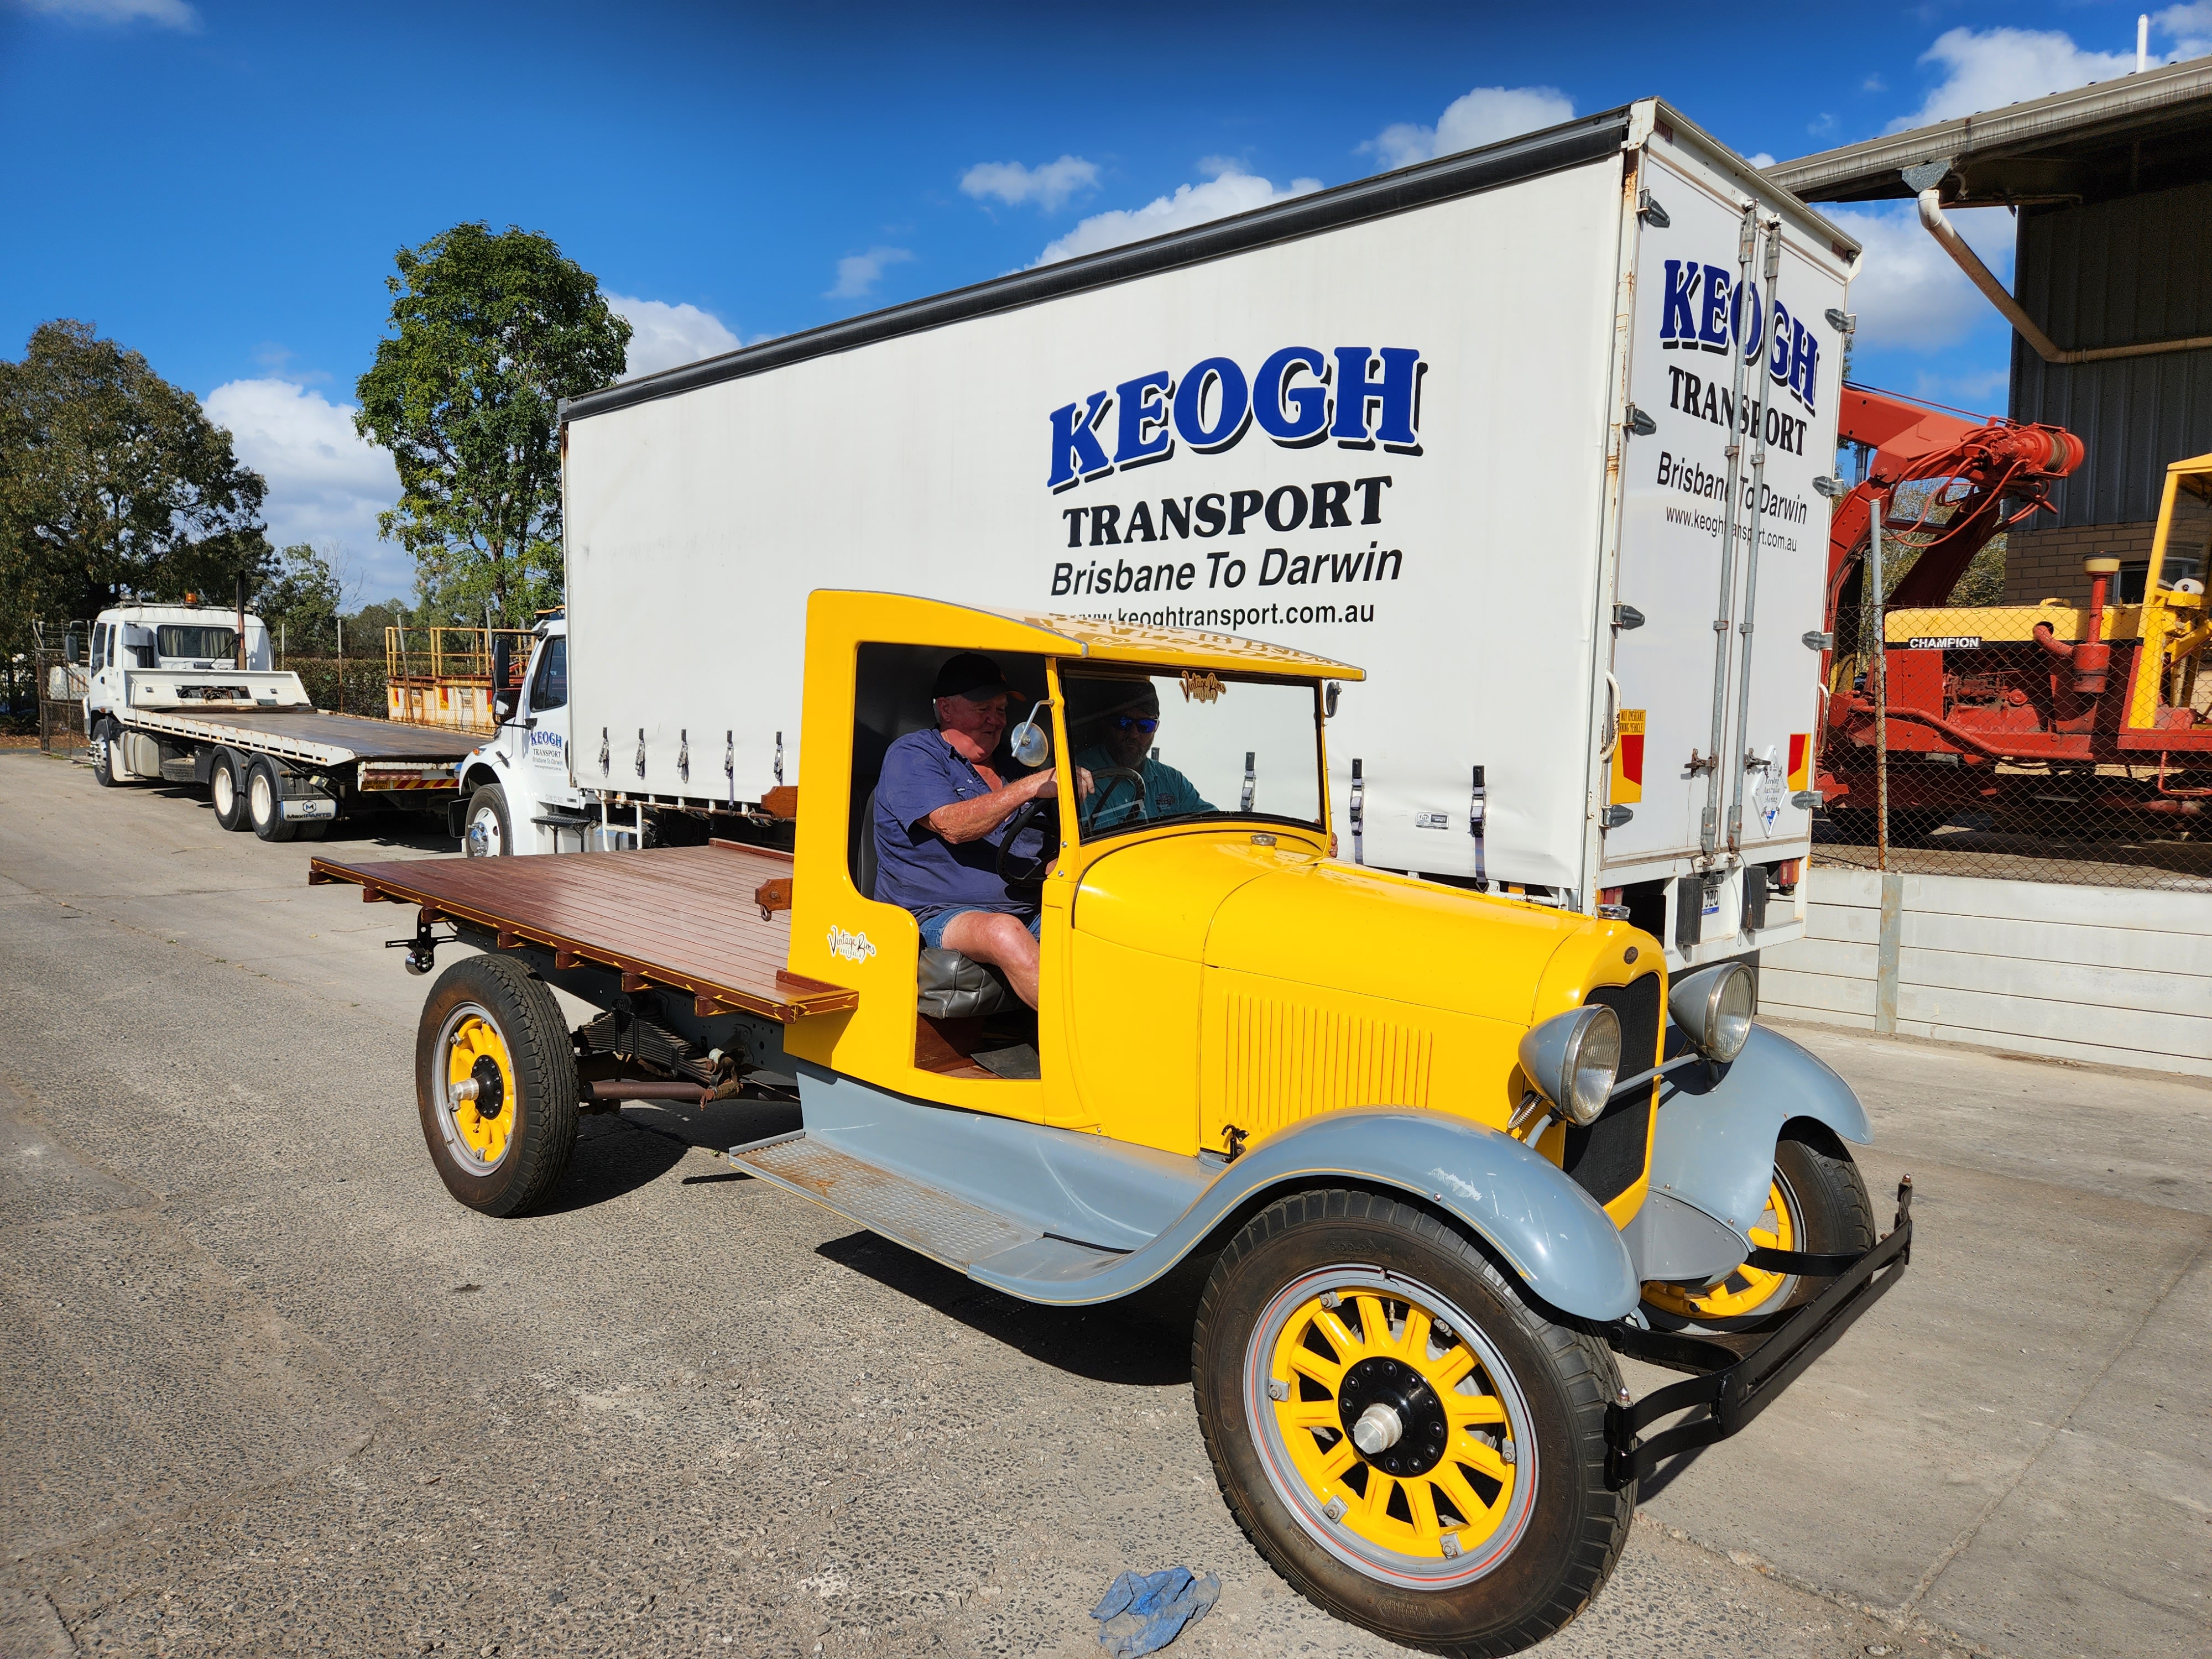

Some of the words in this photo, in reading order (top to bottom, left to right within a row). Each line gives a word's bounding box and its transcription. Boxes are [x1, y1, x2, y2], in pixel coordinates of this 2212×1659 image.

[1660, 260, 1819, 416] KEOGH
[1047, 346, 1428, 494] KEOGH
[1062, 475, 1392, 547] TRANSPORT
[1740, 475, 1754, 510] To
[1760, 483, 1807, 525] Darwin
[1666, 507, 1797, 552] www.keoghansprt.com.au
[1050, 559, 1196, 596] Brisbane
[1207, 551, 1246, 588] To
[1258, 540, 1403, 586] Darwin
[1910, 638, 1979, 648] CHAMPION
[1180, 672, 1208, 701] Vintage
[1620, 722, 1629, 733] RNING
[1630, 722, 1643, 733] VEHICLE
[1628, 711, 1644, 722] OVERTAKE
[531, 731, 563, 750] KEOGH
[533, 748, 561, 758] TRANSPORT
[828, 927, 857, 959] Vintage
[857, 933, 875, 962] Rims
[1534, 1384, 1569, 1496] DENMAN
